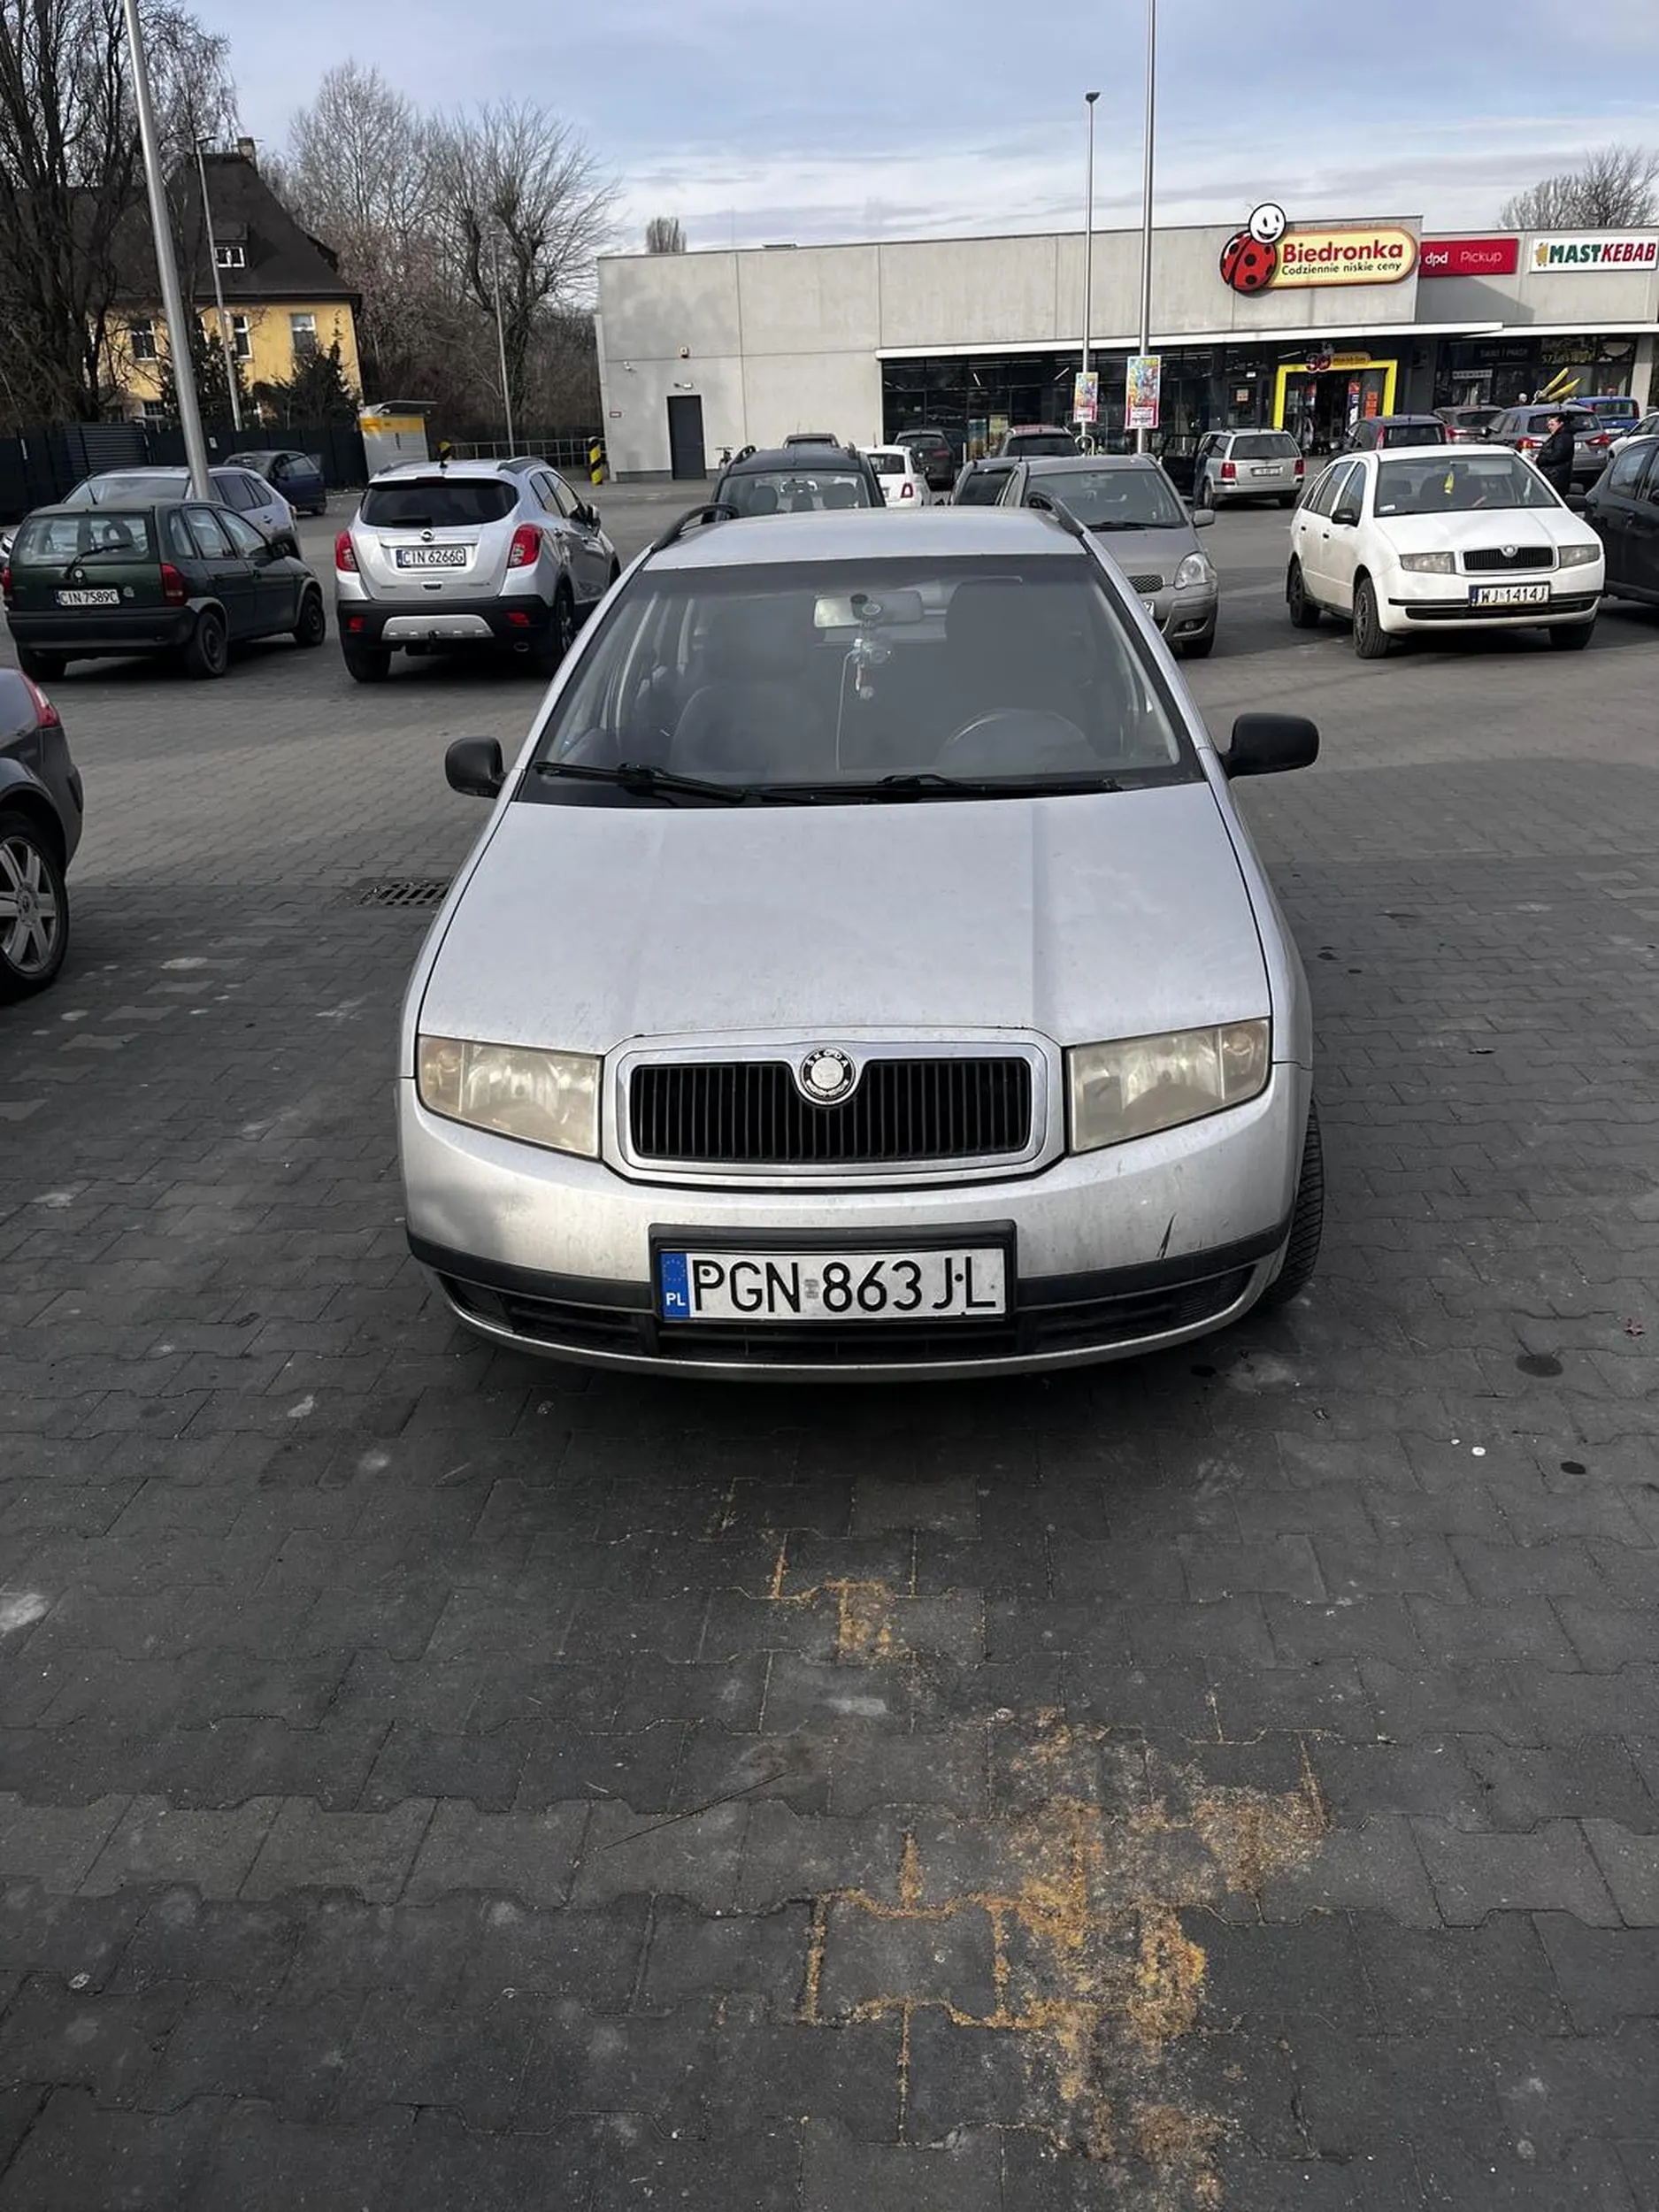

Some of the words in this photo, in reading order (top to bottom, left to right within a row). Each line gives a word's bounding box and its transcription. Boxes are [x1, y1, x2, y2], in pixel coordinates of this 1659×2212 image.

[1283, 240, 1403, 263] Biedronka
[1425, 251, 1448, 266] dpd
[1460, 250, 1502, 264] Pickup
[1282, 265, 1340, 275] Codziennie
[1343, 262, 1373, 272] niskie
[1377, 262, 1402, 272] ceny
[404, 550, 425, 564] CIN
[428, 549, 464, 564] 6266G
[59, 592, 81, 604] CIN
[1481, 589, 1499, 603] WJ
[1506, 588, 1545, 602] 1414J
[692, 1259, 801, 1313] PGN
[665, 1292, 686, 1307] PL
